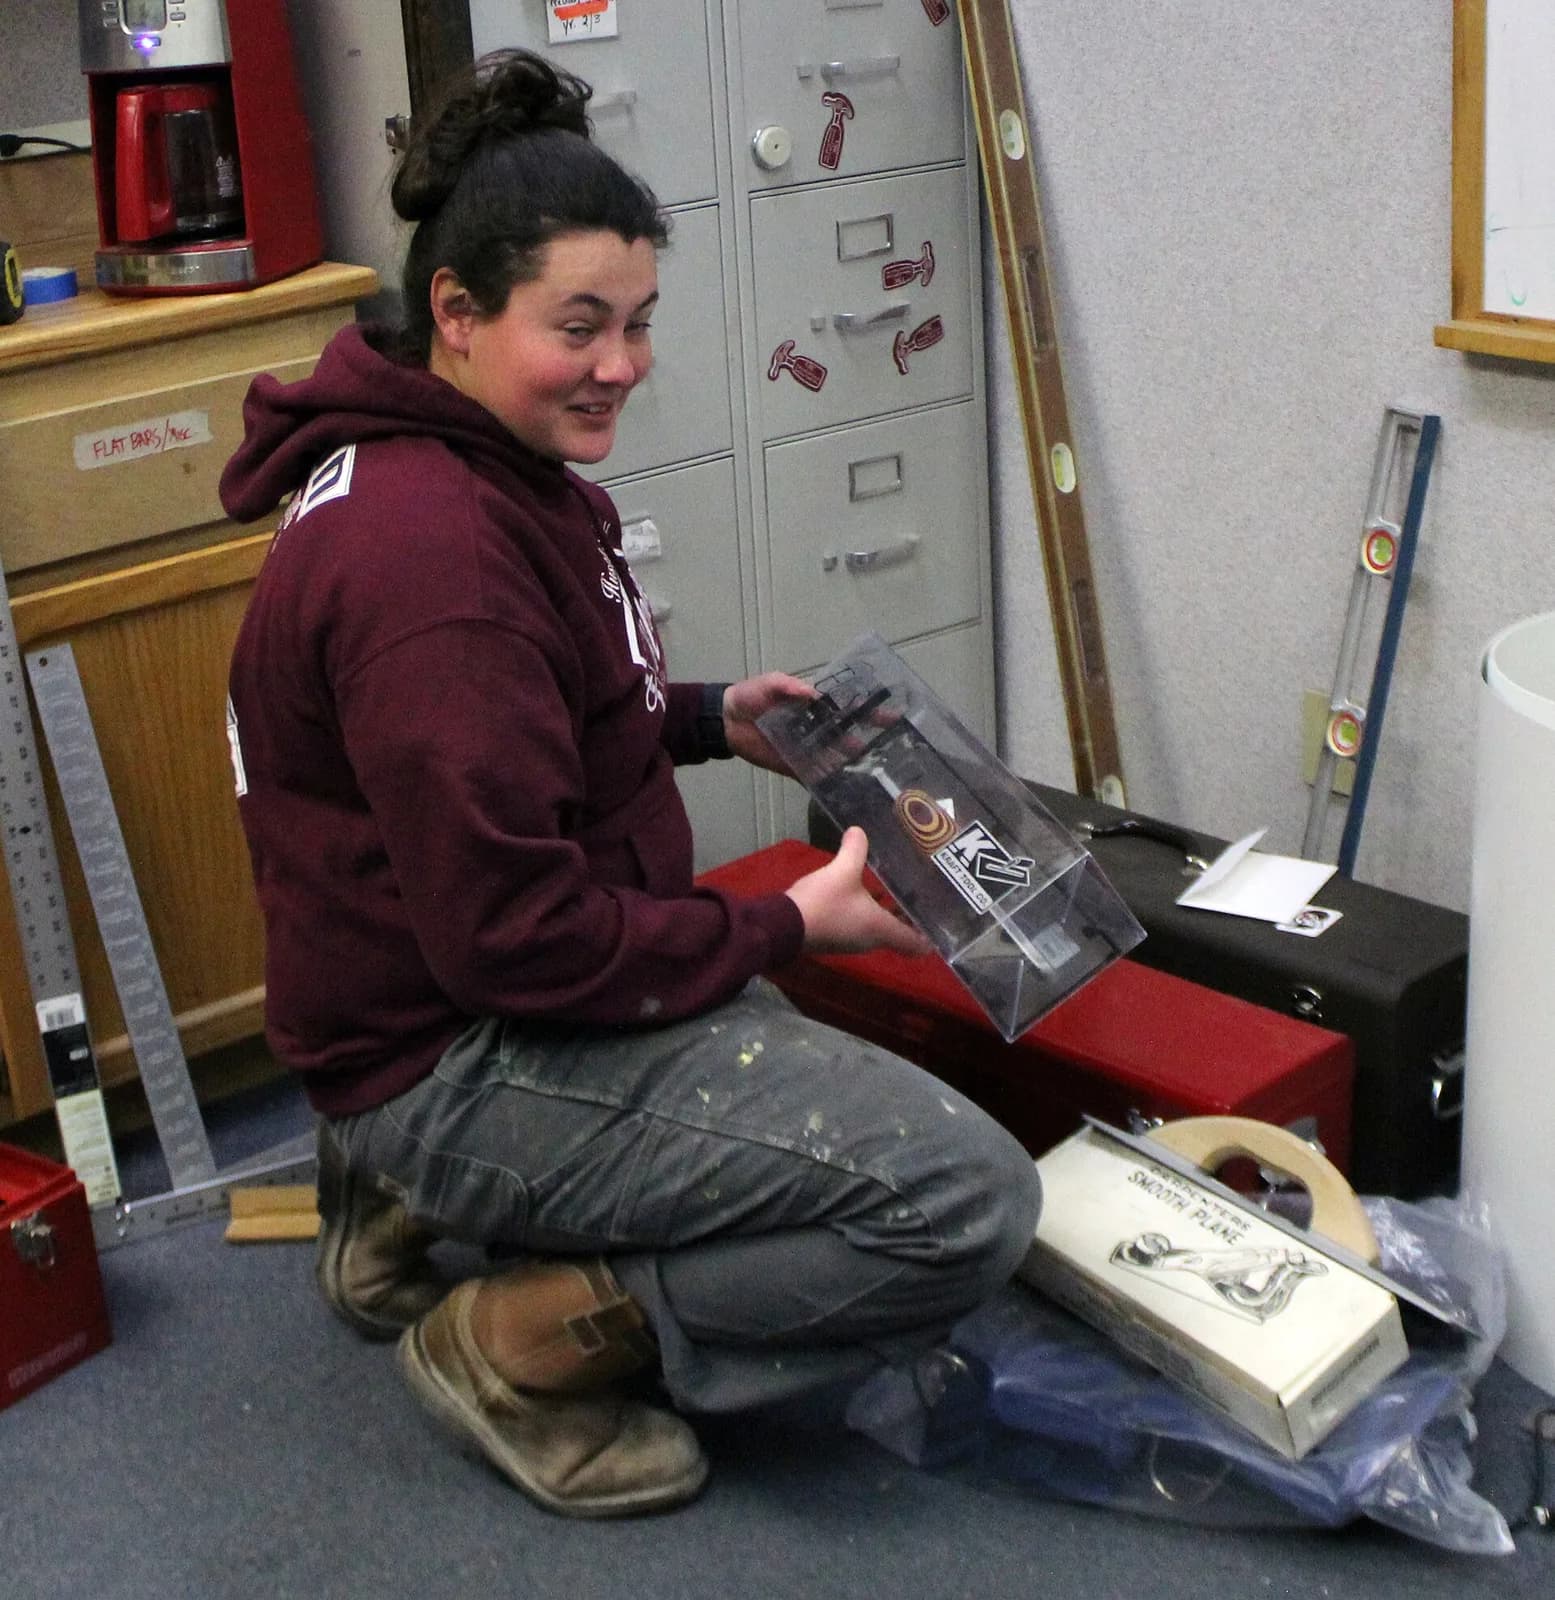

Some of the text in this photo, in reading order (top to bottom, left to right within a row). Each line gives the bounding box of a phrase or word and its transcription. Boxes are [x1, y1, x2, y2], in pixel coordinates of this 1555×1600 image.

[93, 437, 128, 459] FLAT
[941, 852, 962, 874] KRAFT
[960, 874, 976, 893] TOOL
[1127, 1170, 1245, 1246] SMOOTH PLANE
